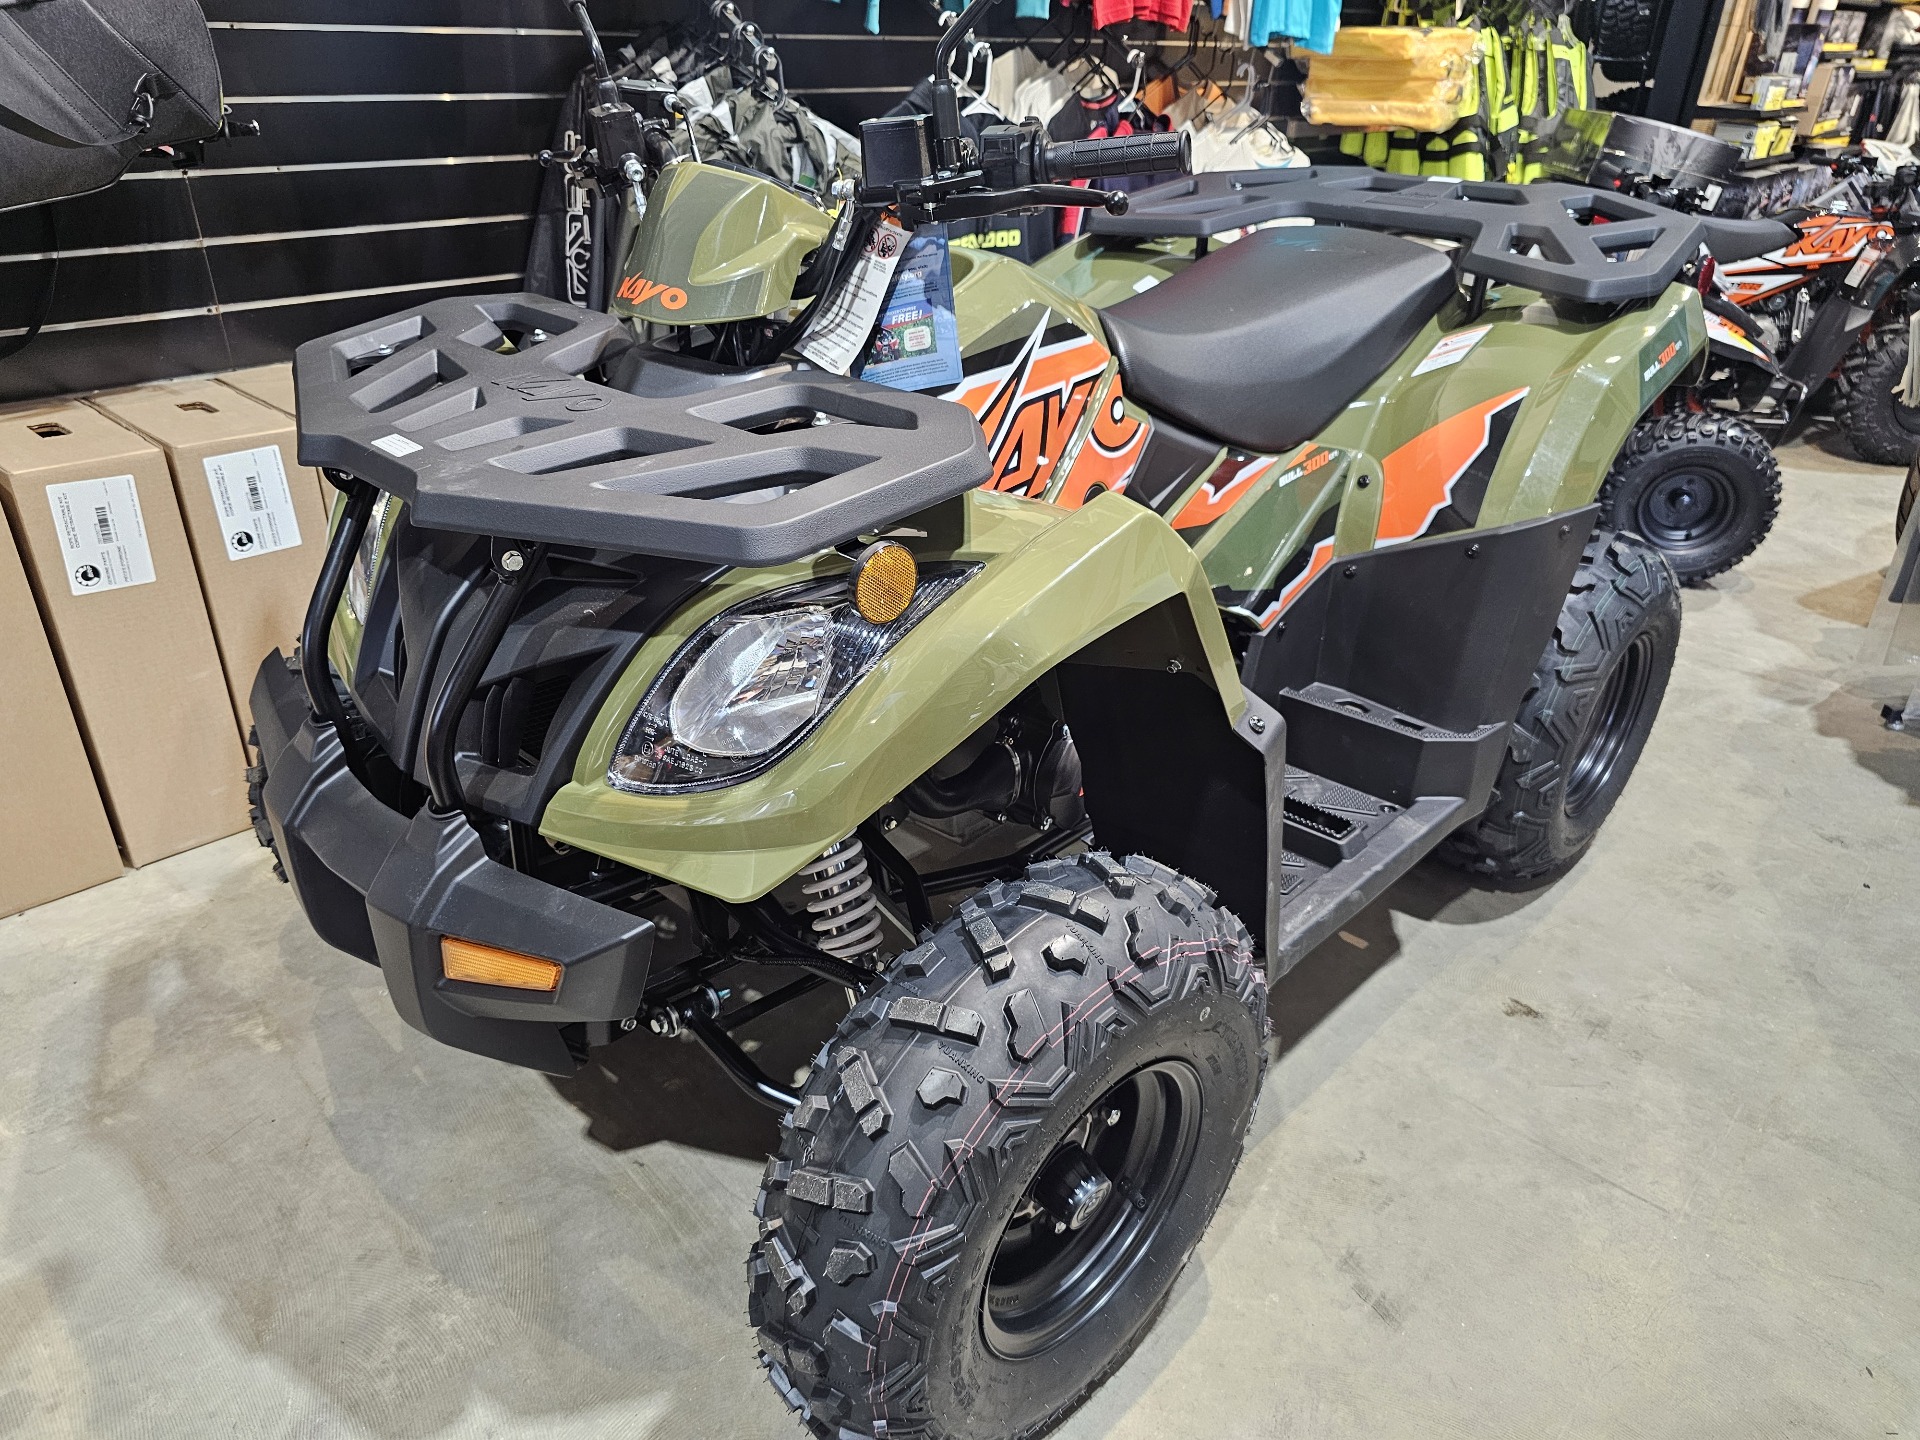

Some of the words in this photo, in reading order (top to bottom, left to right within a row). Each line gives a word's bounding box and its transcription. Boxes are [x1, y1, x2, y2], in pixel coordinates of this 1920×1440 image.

[616, 270, 688, 310] KAYO
[892, 310, 922, 325] FREE!
[1658, 341, 1676, 368] 300
[1279, 467, 1303, 487] BULL
[1303, 450, 1329, 476] 300
[1066, 922, 1104, 966] YUANXING
[938, 1040, 985, 1084] YUANXING
